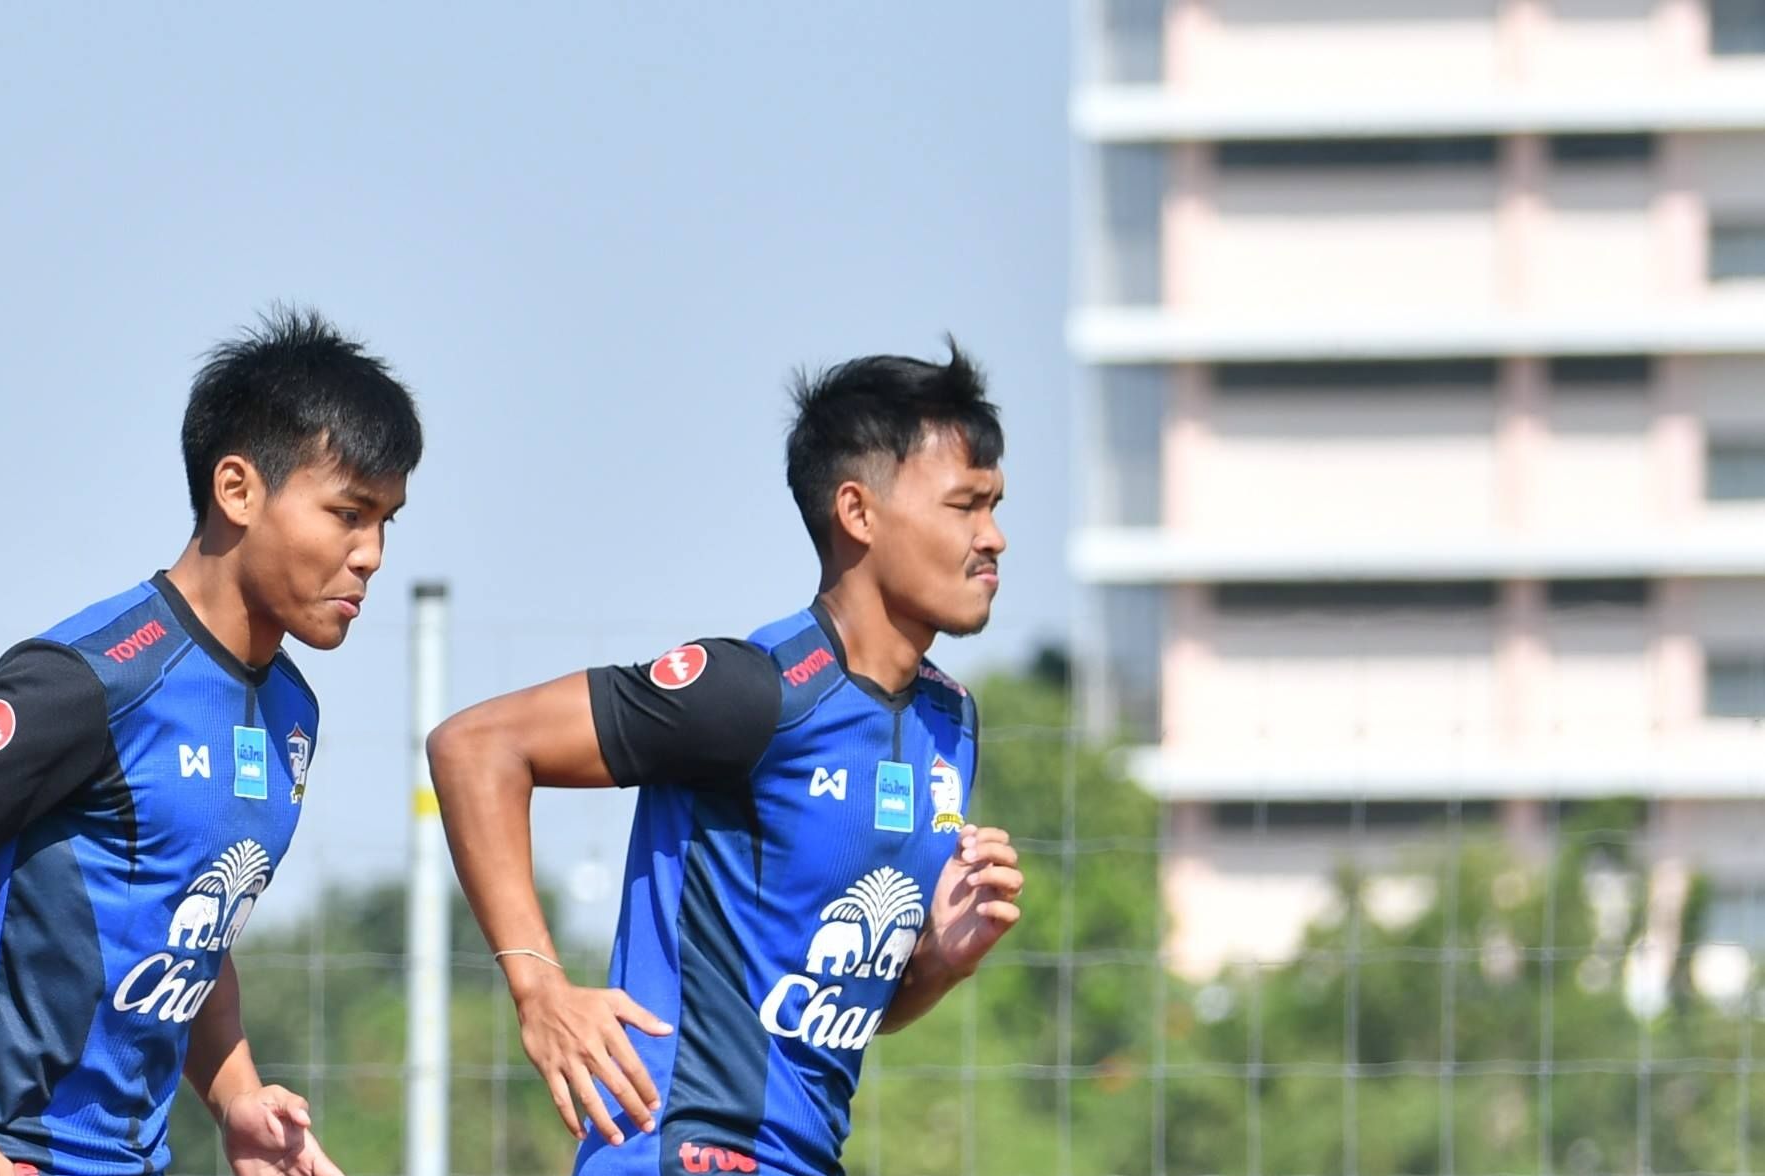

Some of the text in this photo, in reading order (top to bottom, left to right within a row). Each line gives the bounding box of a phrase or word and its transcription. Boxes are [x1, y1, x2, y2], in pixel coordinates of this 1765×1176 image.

[105, 620, 167, 664] TOYOTA
[783, 647, 834, 688] TOYOTA
[113, 952, 216, 1023] Cha
